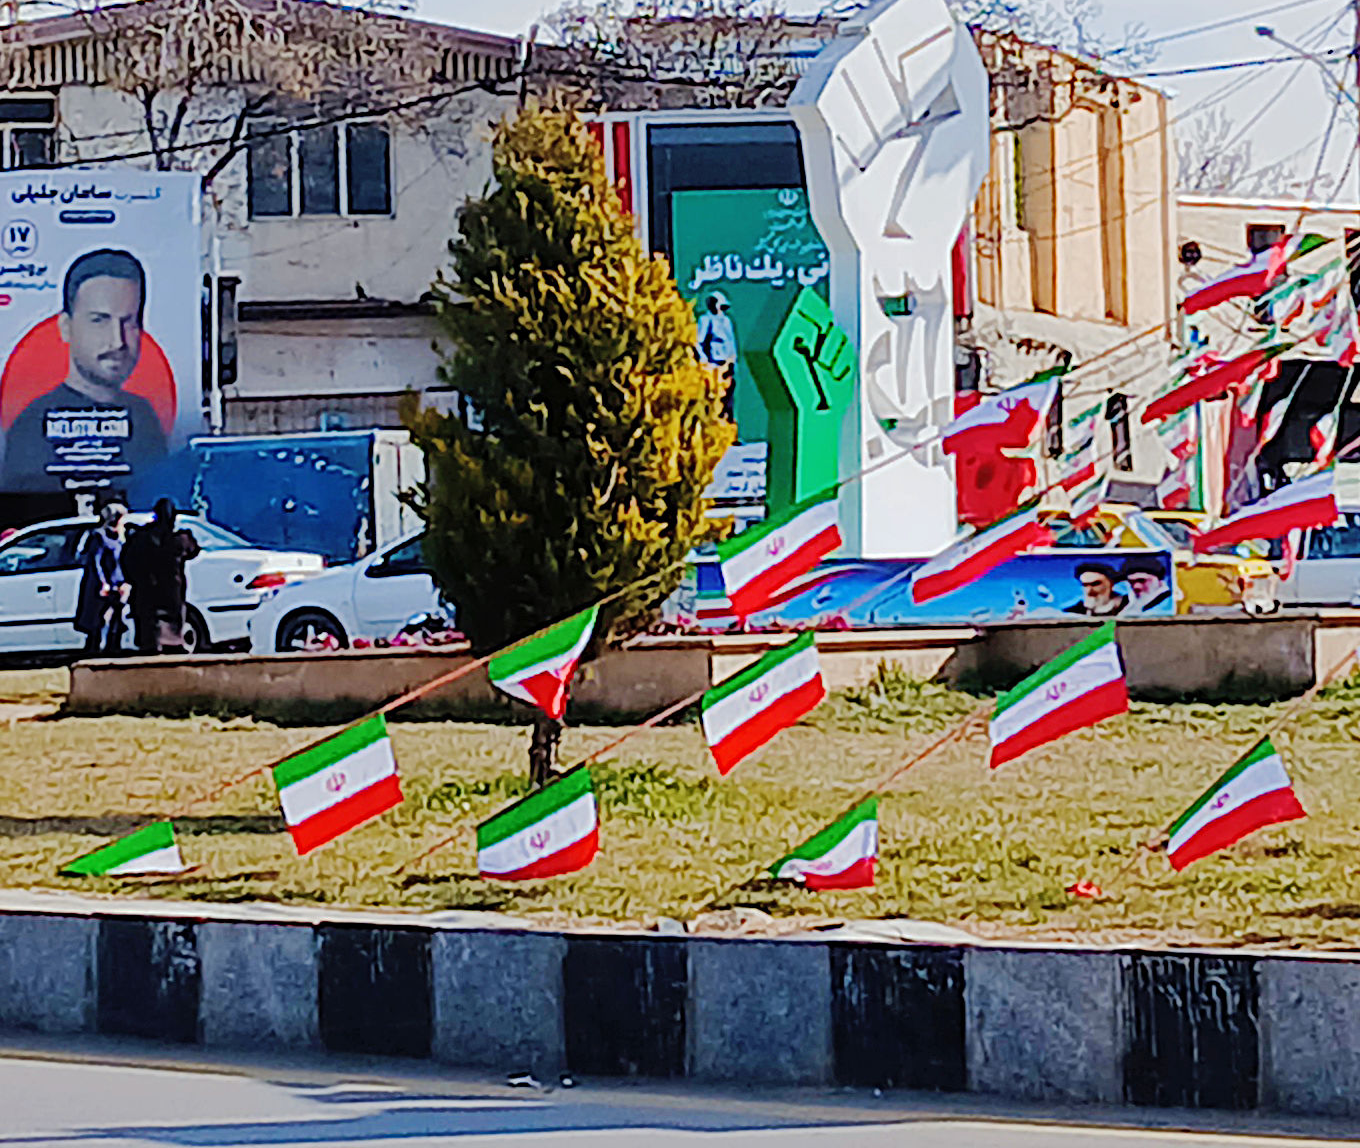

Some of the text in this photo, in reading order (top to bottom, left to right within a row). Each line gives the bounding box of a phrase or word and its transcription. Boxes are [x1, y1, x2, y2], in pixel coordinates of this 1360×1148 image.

[11, 183, 58, 205] جلیلی
[59, 184, 113, 204] سامان
[9, 226, 30, 243] ۱۷
